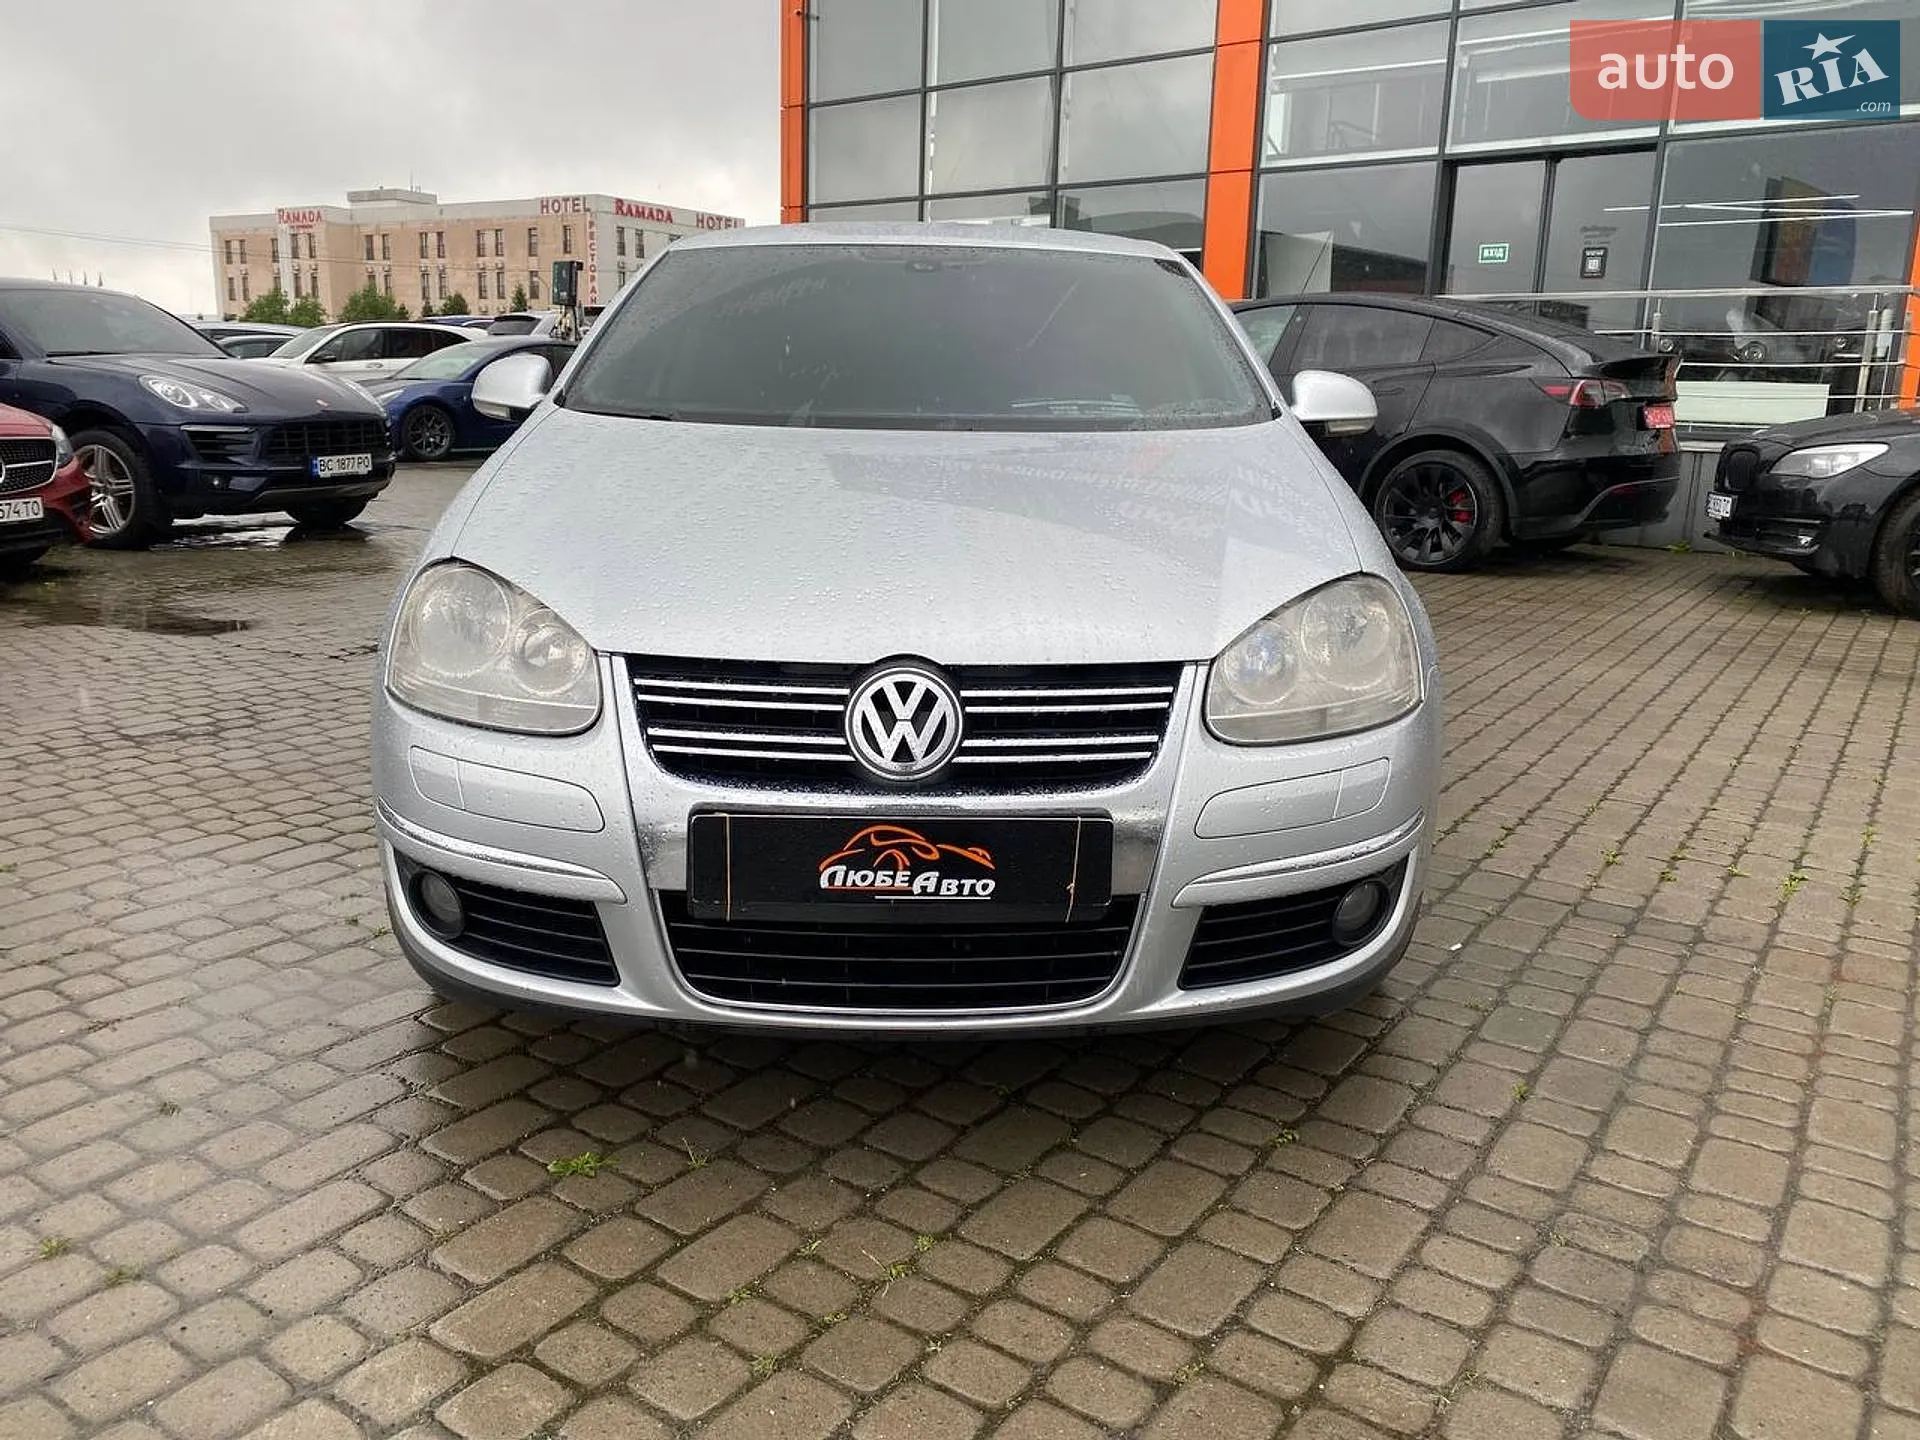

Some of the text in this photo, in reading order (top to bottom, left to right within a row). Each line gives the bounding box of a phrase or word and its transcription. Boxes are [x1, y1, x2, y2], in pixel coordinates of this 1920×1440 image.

[541, 197, 590, 214] HOTEL
[615, 198, 673, 223] RAMADA
[336, 457, 355, 470] 1877
